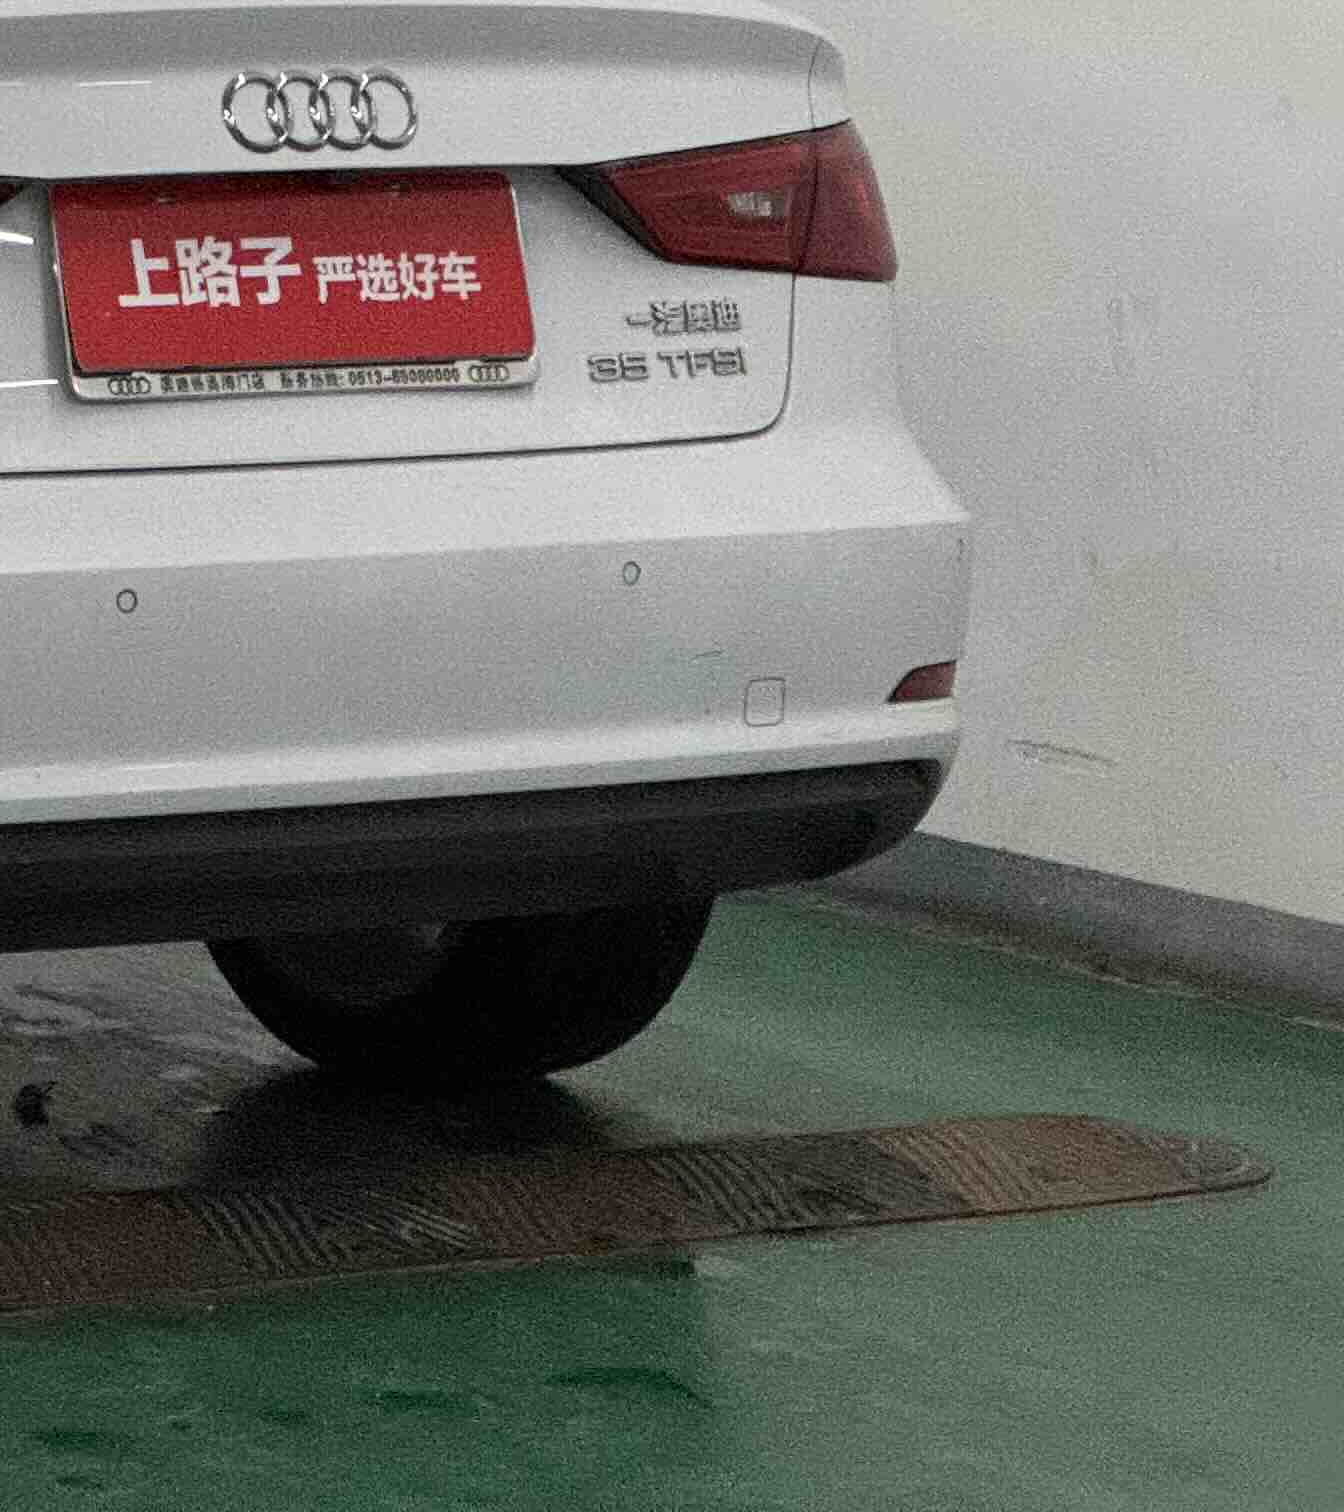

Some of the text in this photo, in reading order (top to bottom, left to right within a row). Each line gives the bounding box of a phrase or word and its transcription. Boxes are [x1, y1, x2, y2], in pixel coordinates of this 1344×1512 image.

[118, 235, 482, 308] 上路子 严选好车
